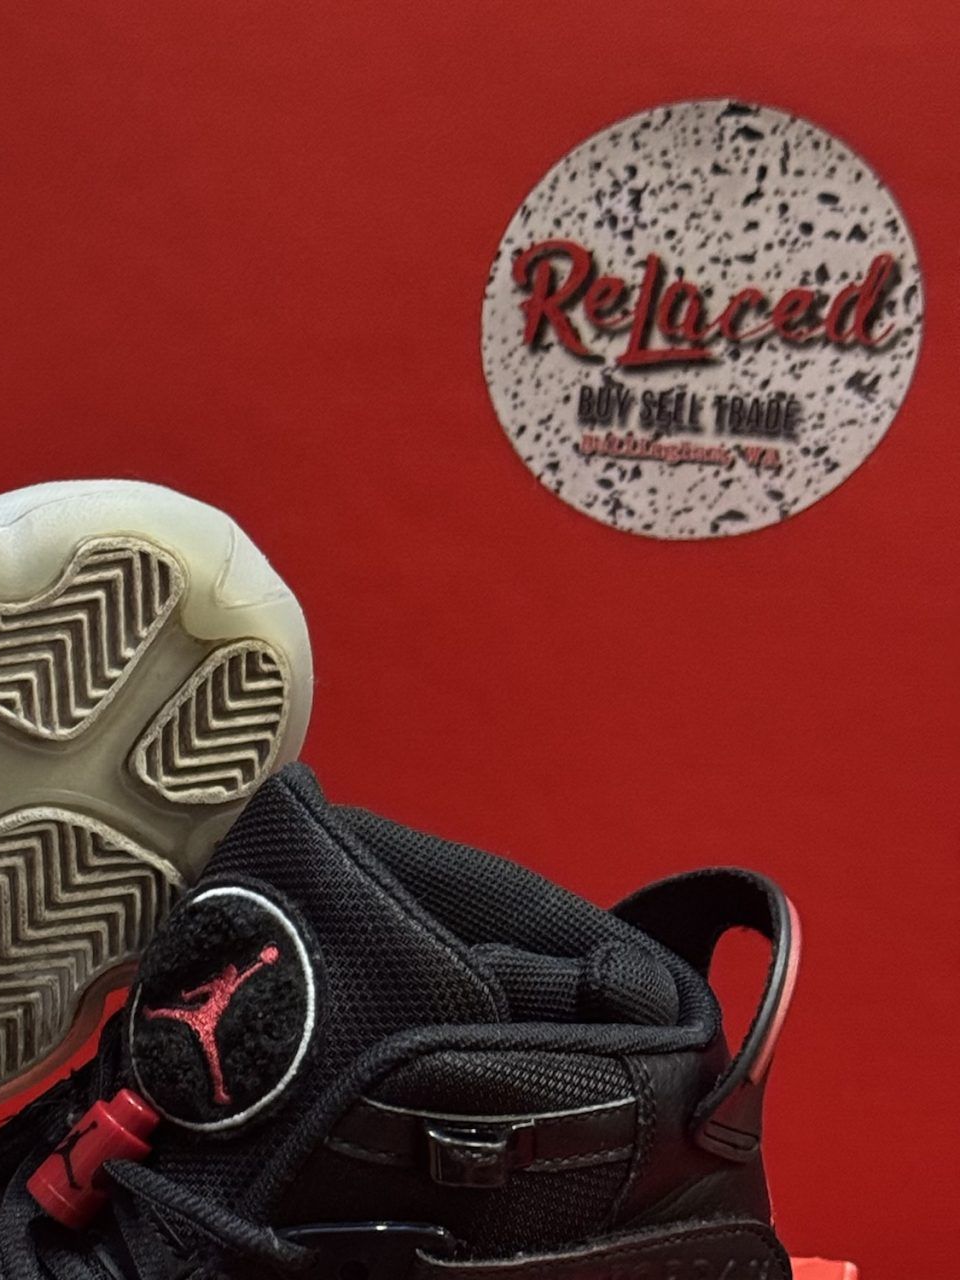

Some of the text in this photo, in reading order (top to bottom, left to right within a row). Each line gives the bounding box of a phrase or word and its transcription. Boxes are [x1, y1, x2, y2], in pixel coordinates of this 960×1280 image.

[512, 238, 898, 366] ReLaced
[577, 384, 802, 437] BUY SELL TRADE
